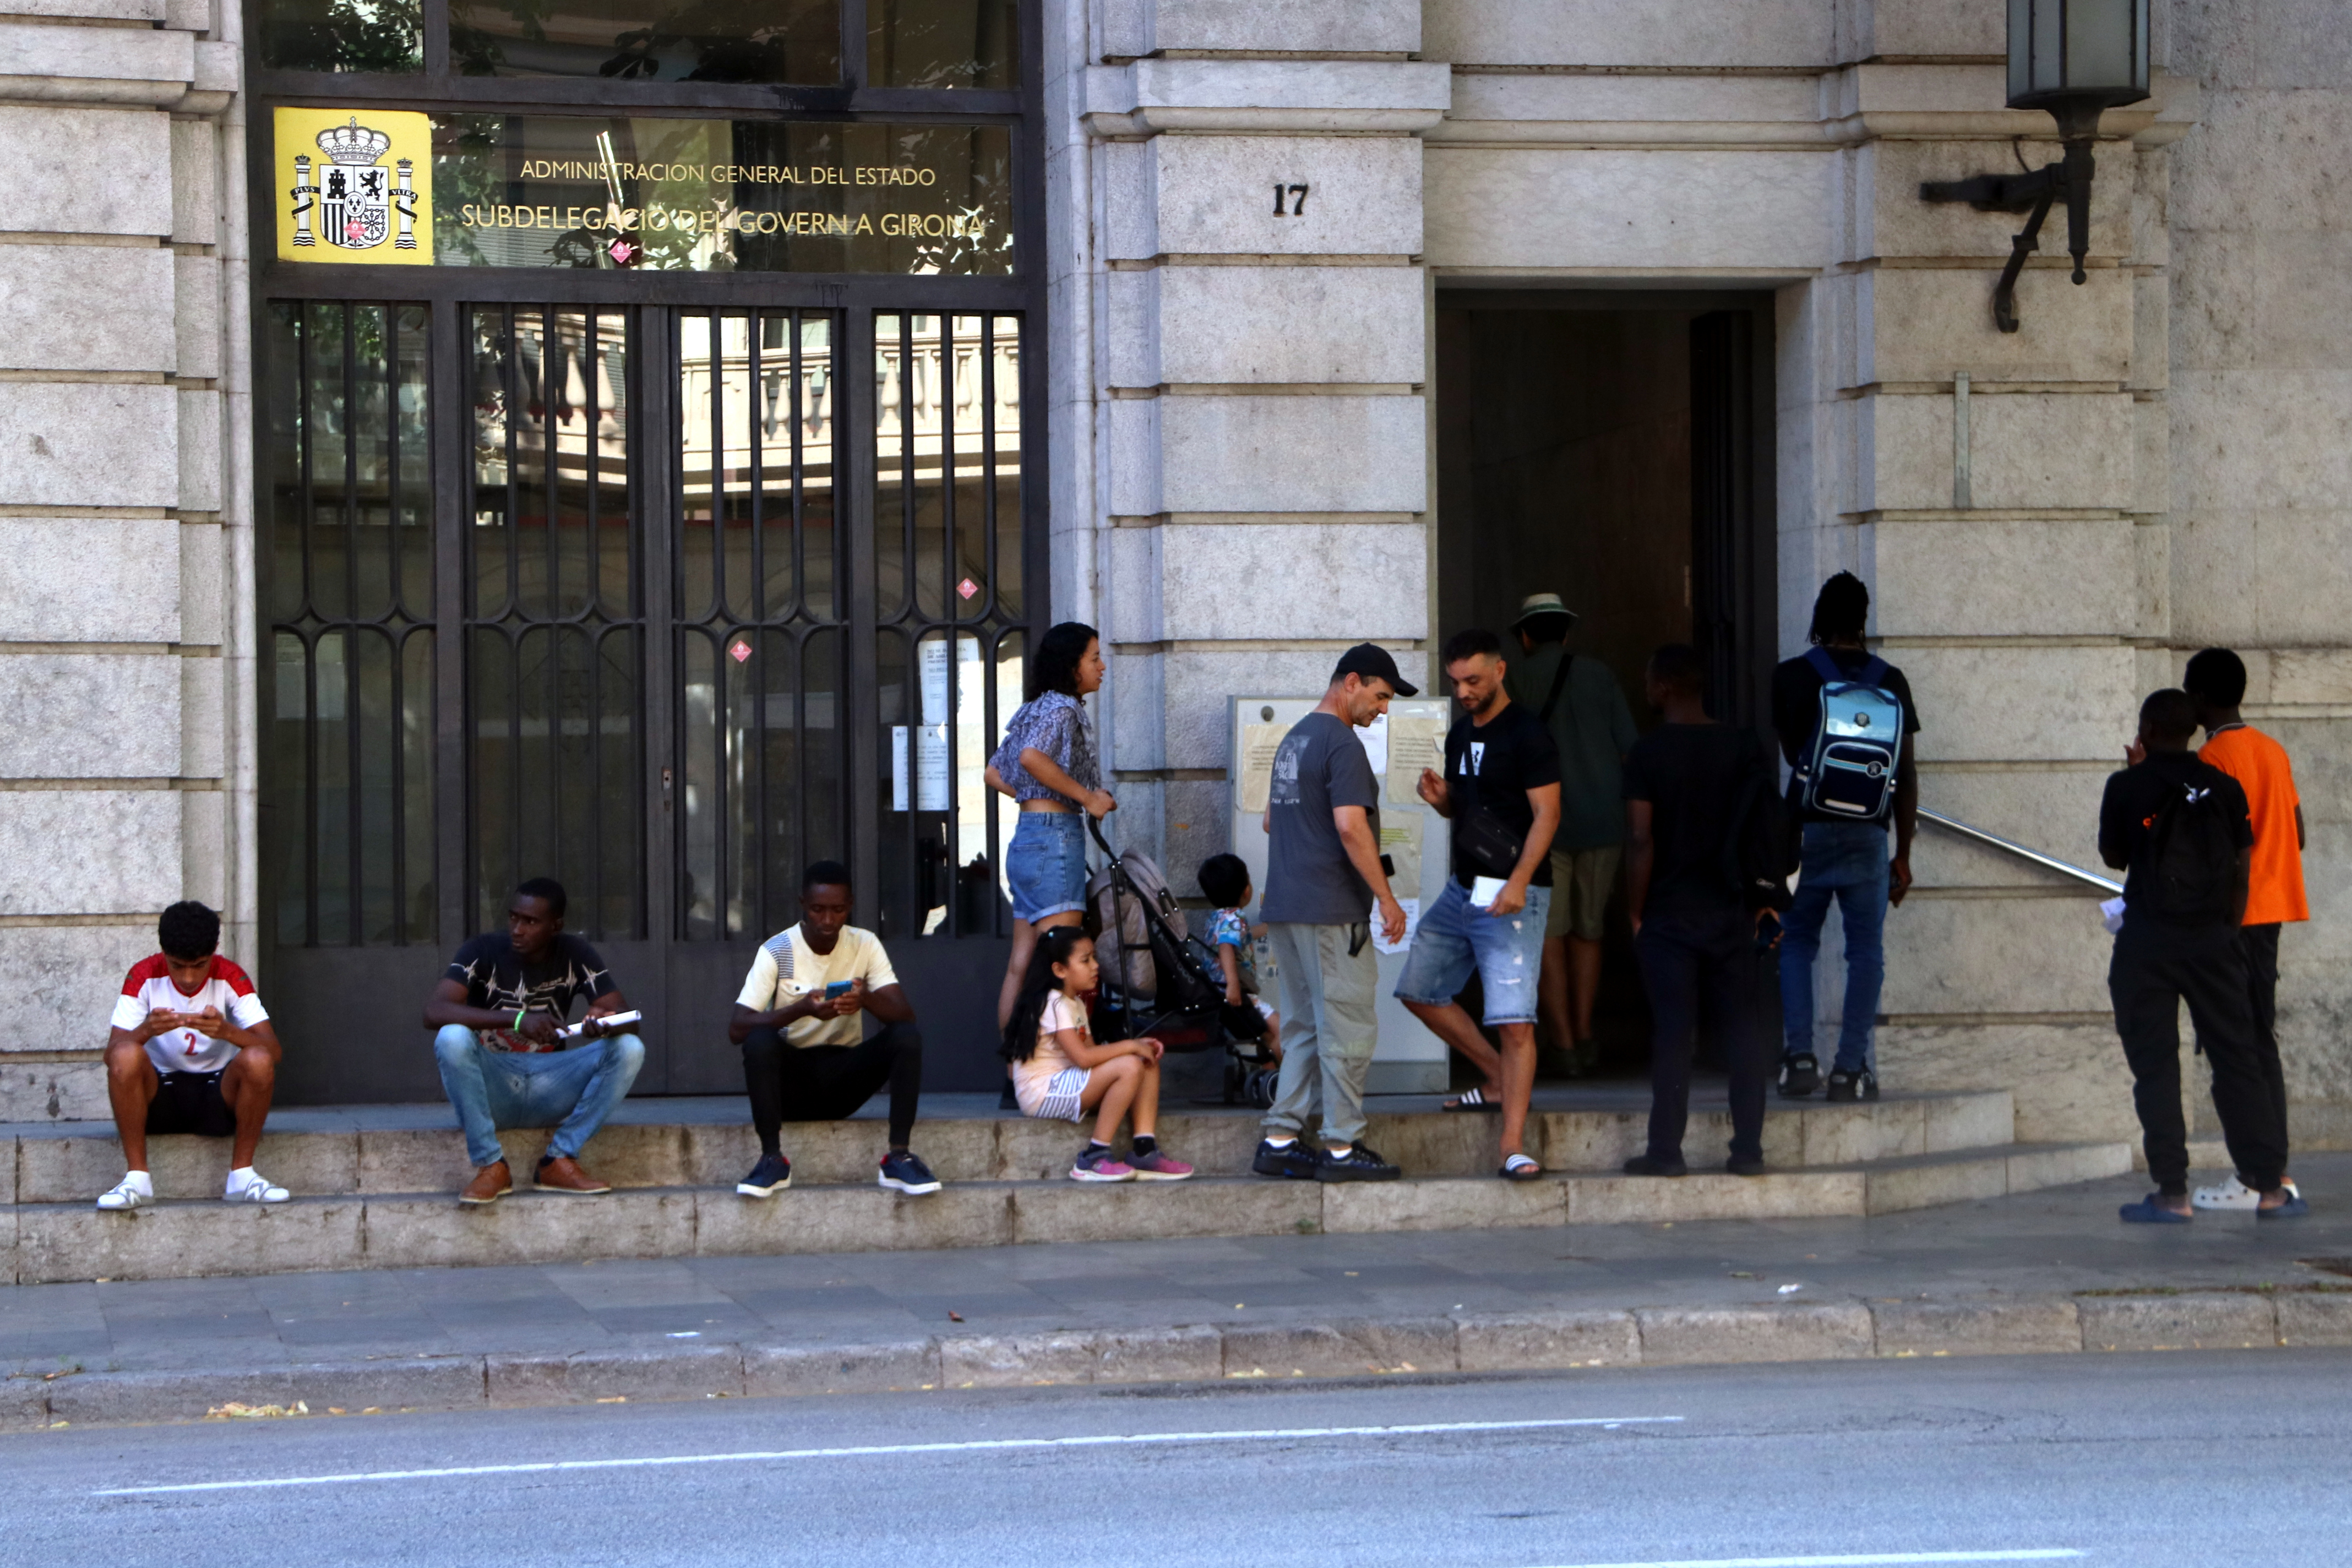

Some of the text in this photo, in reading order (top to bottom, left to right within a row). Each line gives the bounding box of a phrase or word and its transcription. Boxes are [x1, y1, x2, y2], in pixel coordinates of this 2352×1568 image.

[520, 160, 936, 186] ADMINISTRACION GENERAL DEL ESTADO
[1272, 183, 1309, 216] 17
[461, 204, 986, 237] SUBDELEGACIO DEL GOVERN A GIRONA
[184, 1032, 199, 1056] 2
